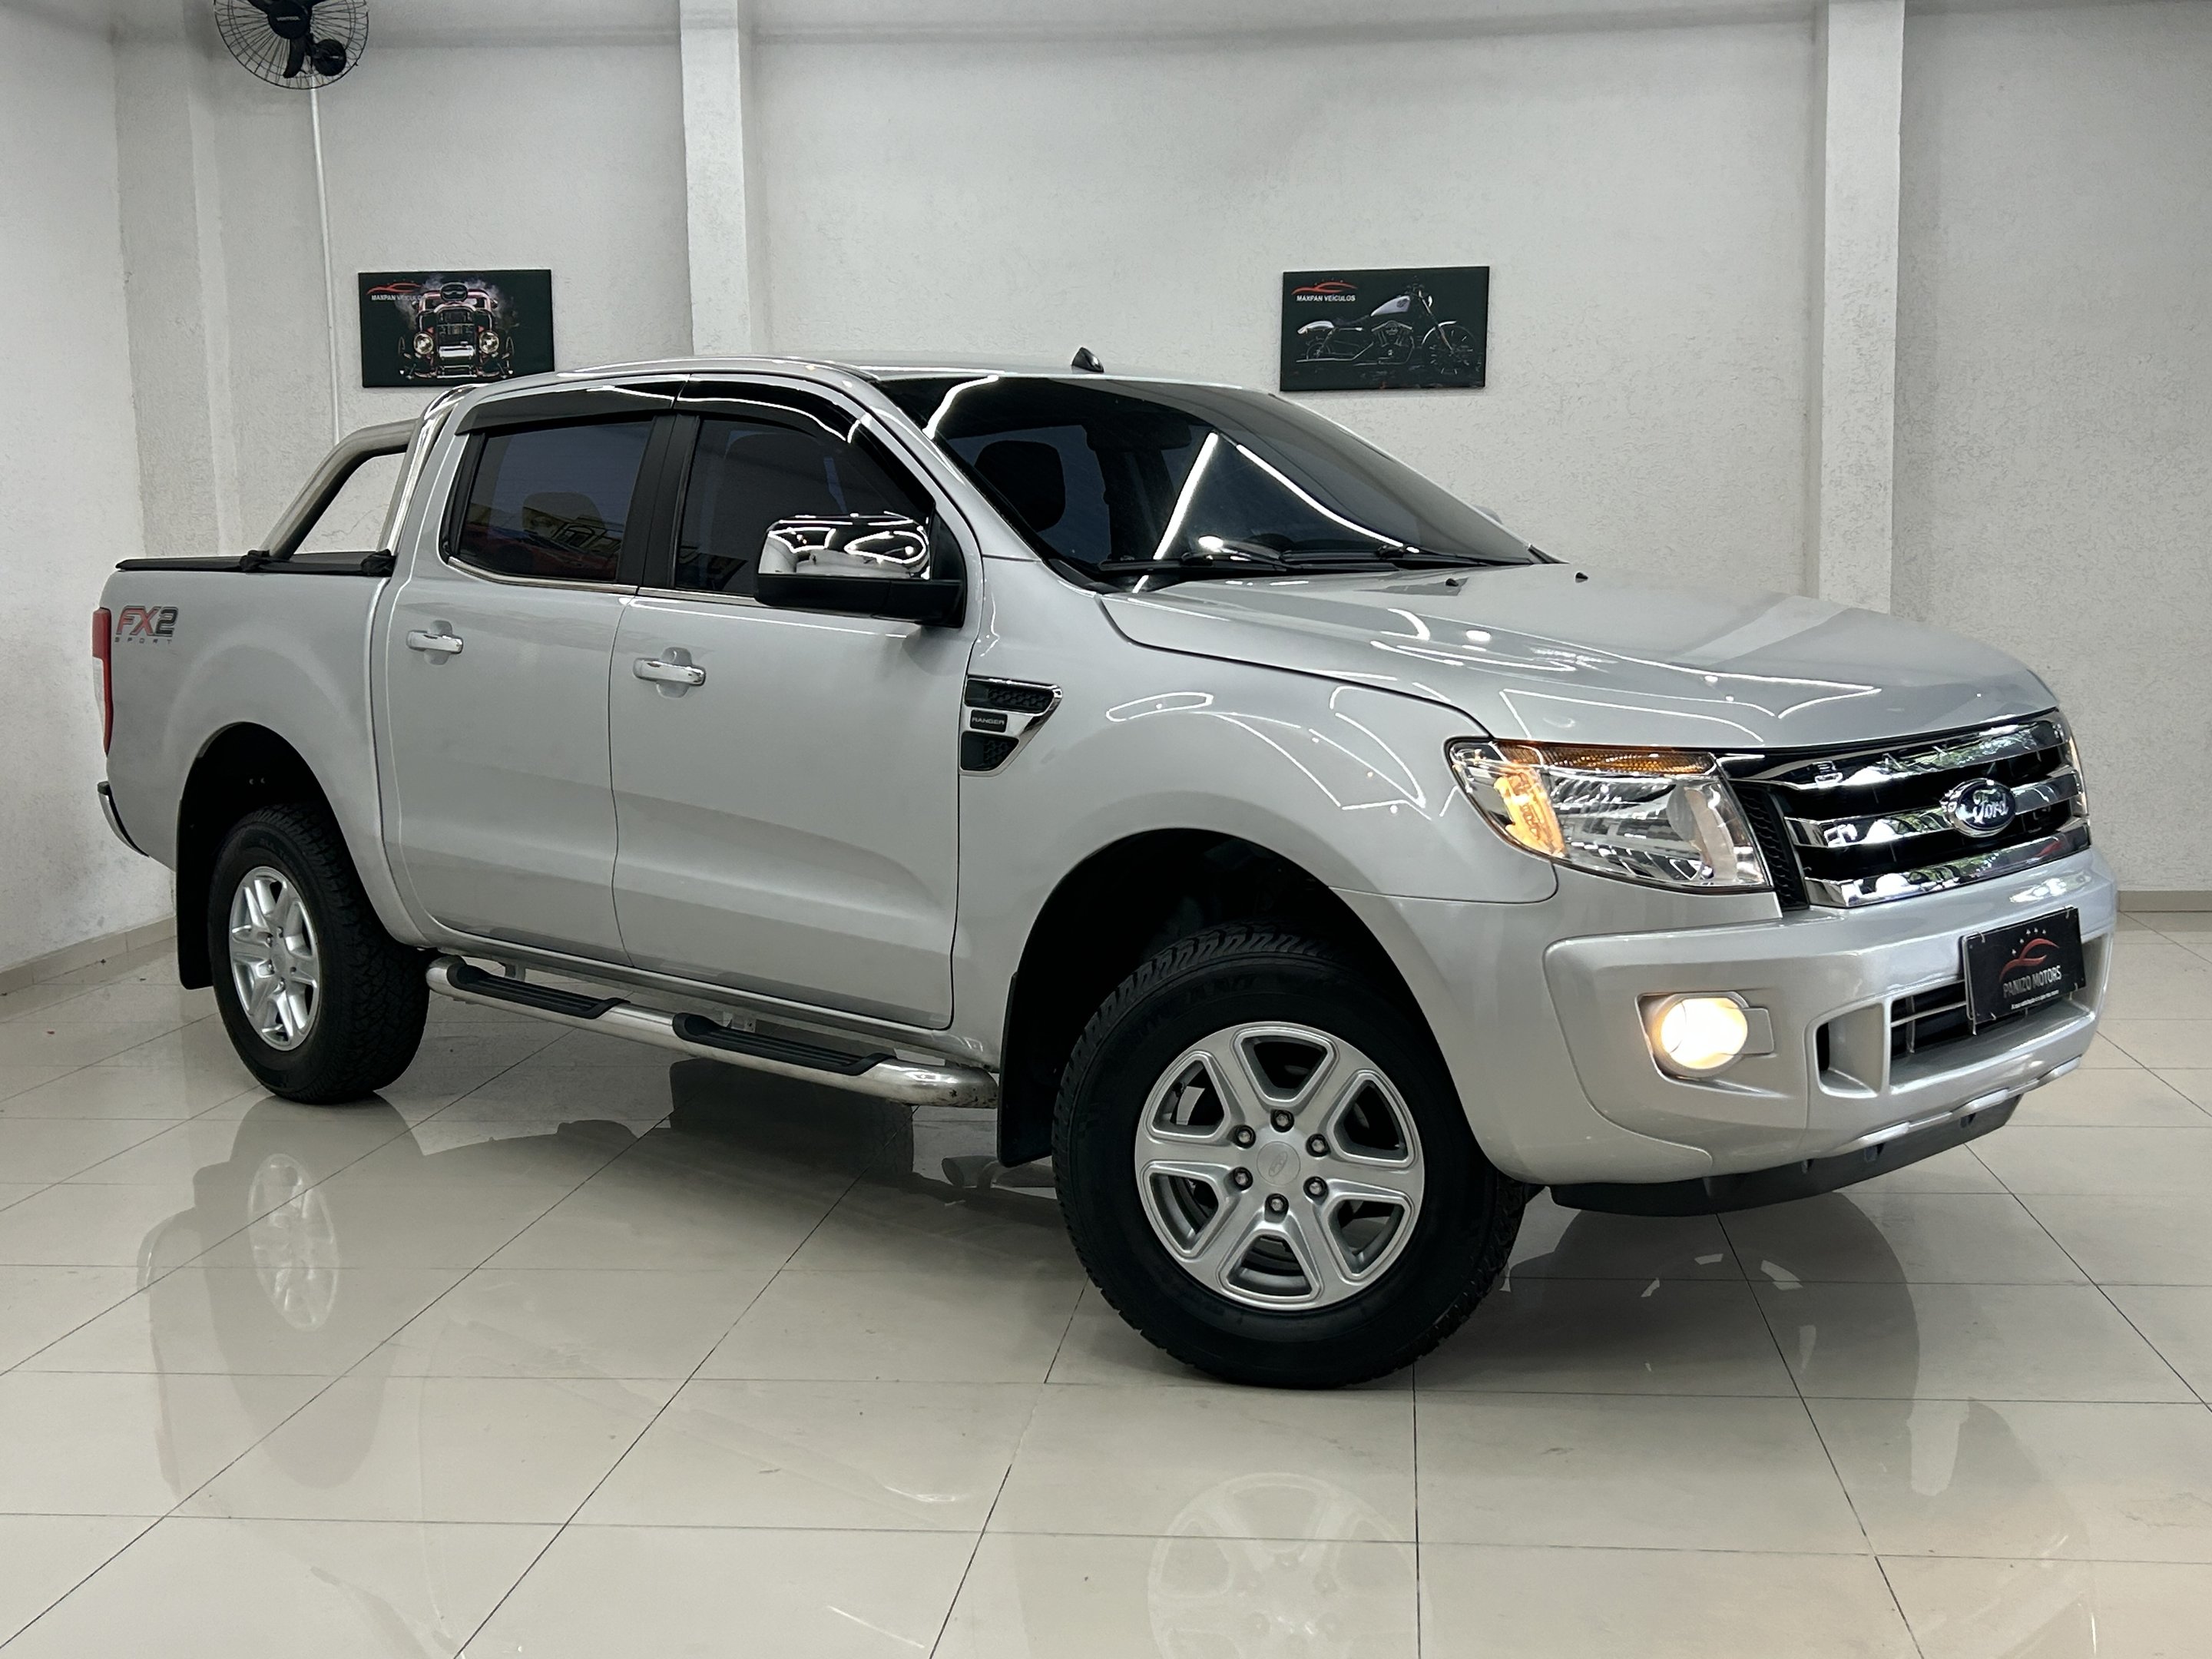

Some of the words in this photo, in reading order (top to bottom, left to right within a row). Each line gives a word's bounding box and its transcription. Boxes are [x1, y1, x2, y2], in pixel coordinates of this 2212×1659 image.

[116, 605, 178, 637] FX2
[972, 717, 1005, 725] RANGER
[2003, 975, 2032, 998] PANIZO
[2032, 965, 2061, 988] MOTORS
